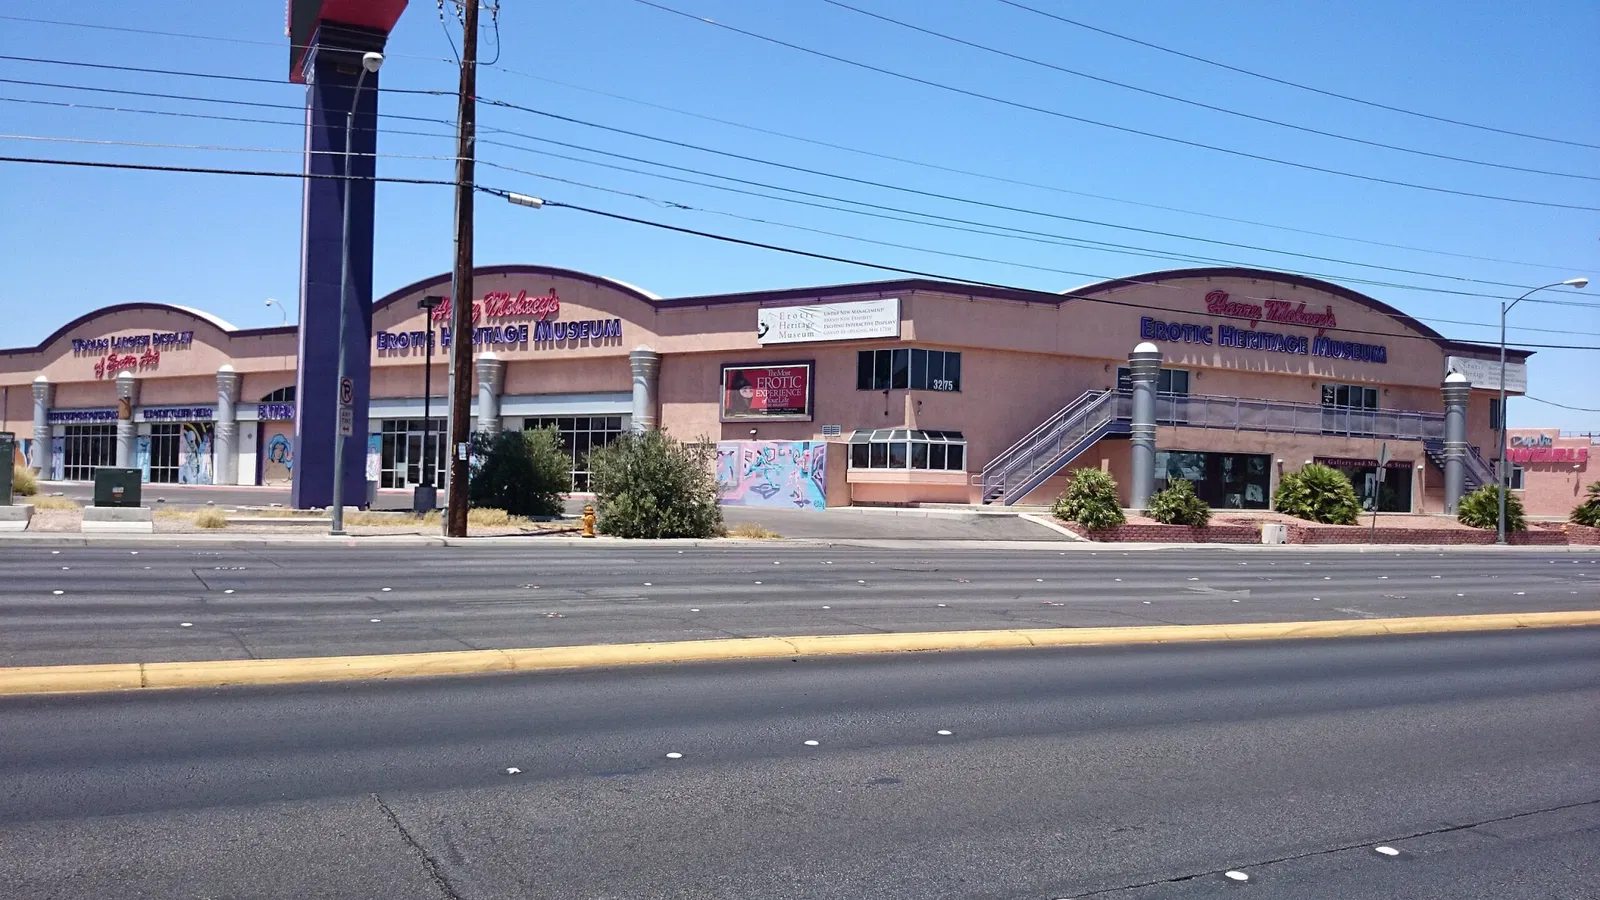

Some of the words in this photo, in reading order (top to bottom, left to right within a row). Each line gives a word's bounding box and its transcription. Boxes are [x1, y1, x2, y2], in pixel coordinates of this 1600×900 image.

[484, 288, 560, 321] Mohney's
[779, 312, 815, 321] Erotic
[1205, 290, 1262, 328] Harry
[1265, 298, 1336, 335] Mohney's
[441, 325, 529, 346] HITAGE
[534, 319, 622, 342] MUSEUM
[779, 321, 815, 331] Heritage
[72, 339, 109, 352] WORLDS
[111, 335, 151, 349] LARGEST
[152, 331, 194, 346] DISPLAY
[779, 331, 815, 339] Museum
[1140, 316, 1213, 345] EROTIC
[1218, 325, 1308, 355] HERITAGE
[1312, 335, 1387, 364] MUSEUM
[757, 375, 802, 389] EROTIC
[933, 379, 953, 391] 3275
[755, 388, 802, 397] EXPERIENCE
[762, 396, 768, 404] of
[1506, 448, 1588, 462] OWGIRLS
